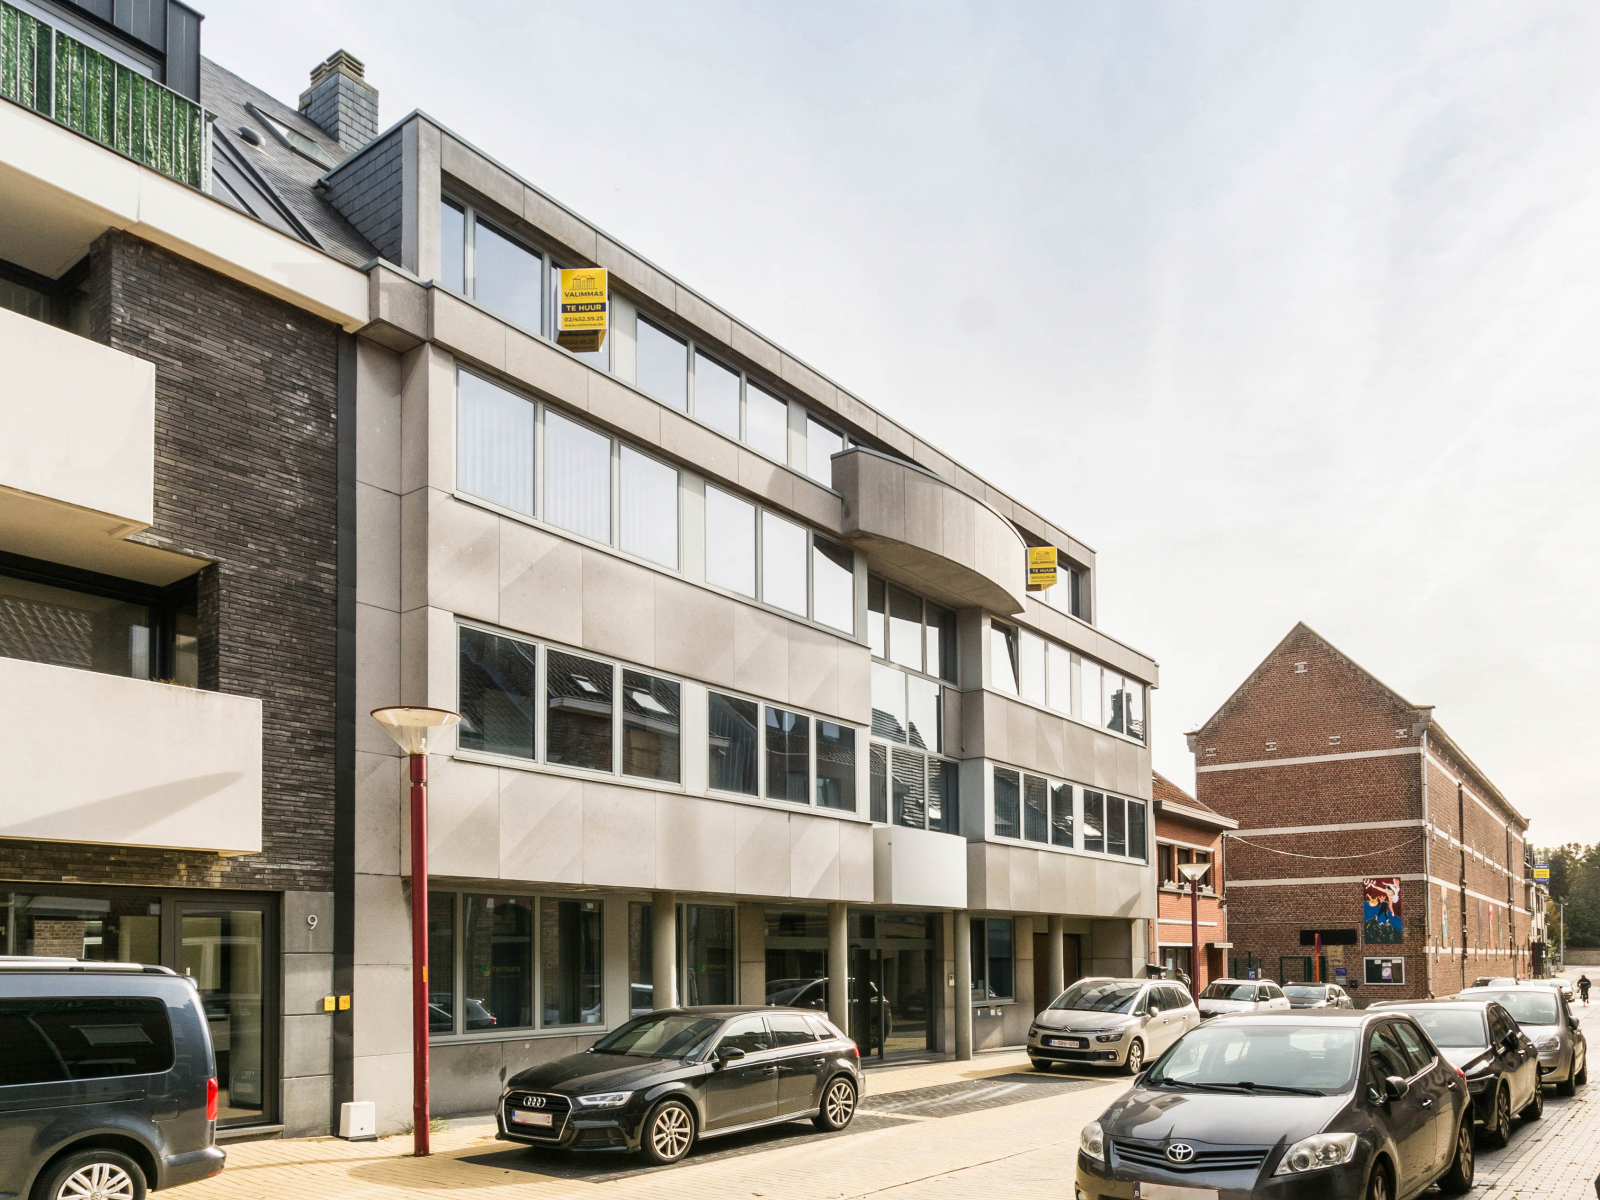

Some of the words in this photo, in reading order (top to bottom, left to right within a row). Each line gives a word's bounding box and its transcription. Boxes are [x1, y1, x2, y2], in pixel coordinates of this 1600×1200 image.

[564, 290, 604, 298] VALIMMAS
[564, 315, 604, 323] 02/452.59.25
[307, 914, 318, 930] 9
[491, 965, 521, 973] mensura
